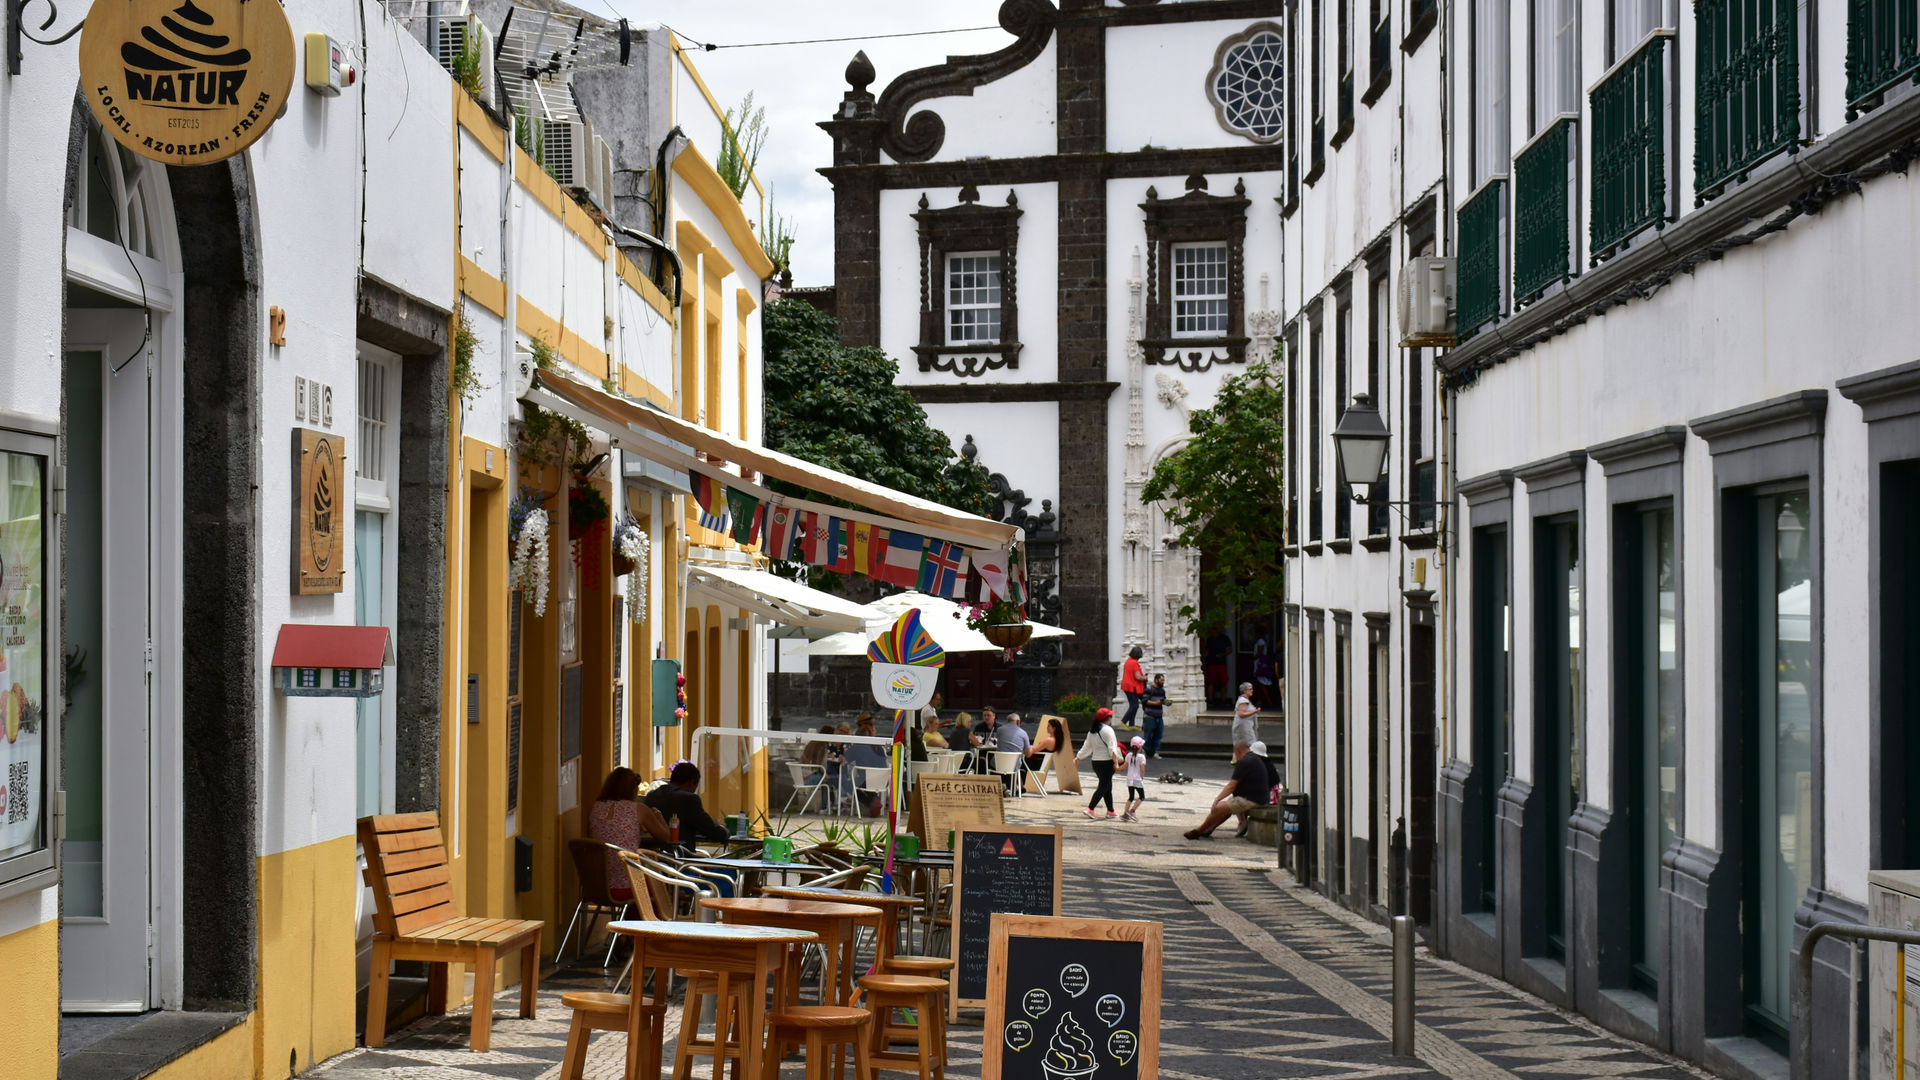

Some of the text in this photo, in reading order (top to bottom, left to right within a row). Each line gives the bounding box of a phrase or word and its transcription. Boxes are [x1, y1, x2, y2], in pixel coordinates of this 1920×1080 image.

[124, 67, 247, 106] NATUR
[97, 85, 271, 156] LOCAL AZOREAN FRESH
[892, 686, 914, 694] NATUR
[926, 781, 998, 795] CAFÉ CENTRAL
